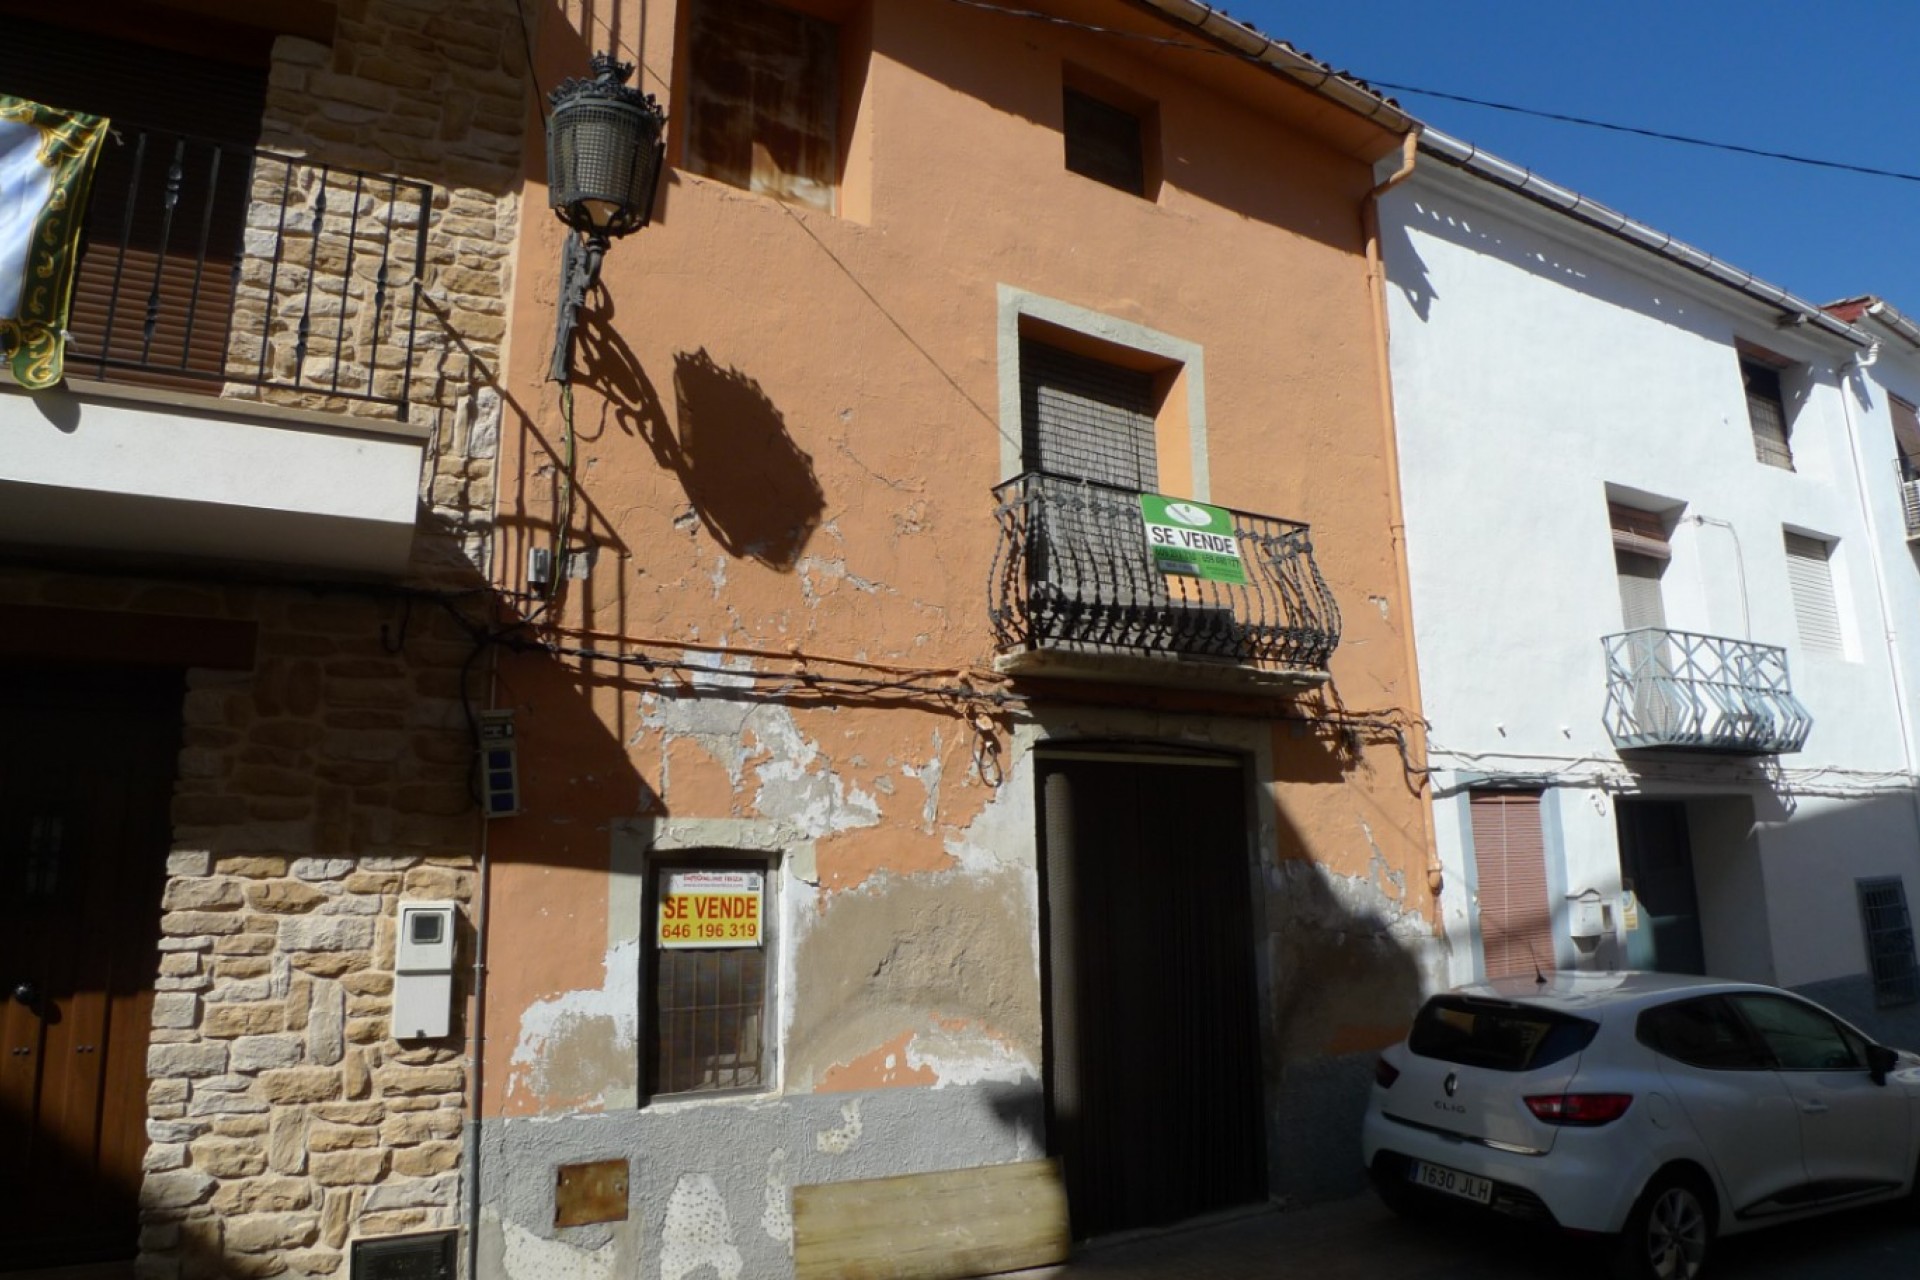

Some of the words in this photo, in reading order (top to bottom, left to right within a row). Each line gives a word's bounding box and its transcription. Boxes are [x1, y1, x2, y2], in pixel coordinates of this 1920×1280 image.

[1151, 525, 1175, 545] SE
[1179, 529, 1235, 555] VENDE
[664, 896, 688, 919] SE
[694, 896, 757, 919] VENDE
[662, 924, 691, 938] 646
[697, 923, 724, 938] 196
[729, 923, 756, 937] 319
[1433, 1100, 1466, 1114] CLIO
[1422, 1165, 1455, 1189] 1630
[1459, 1177, 1489, 1200] JLH
